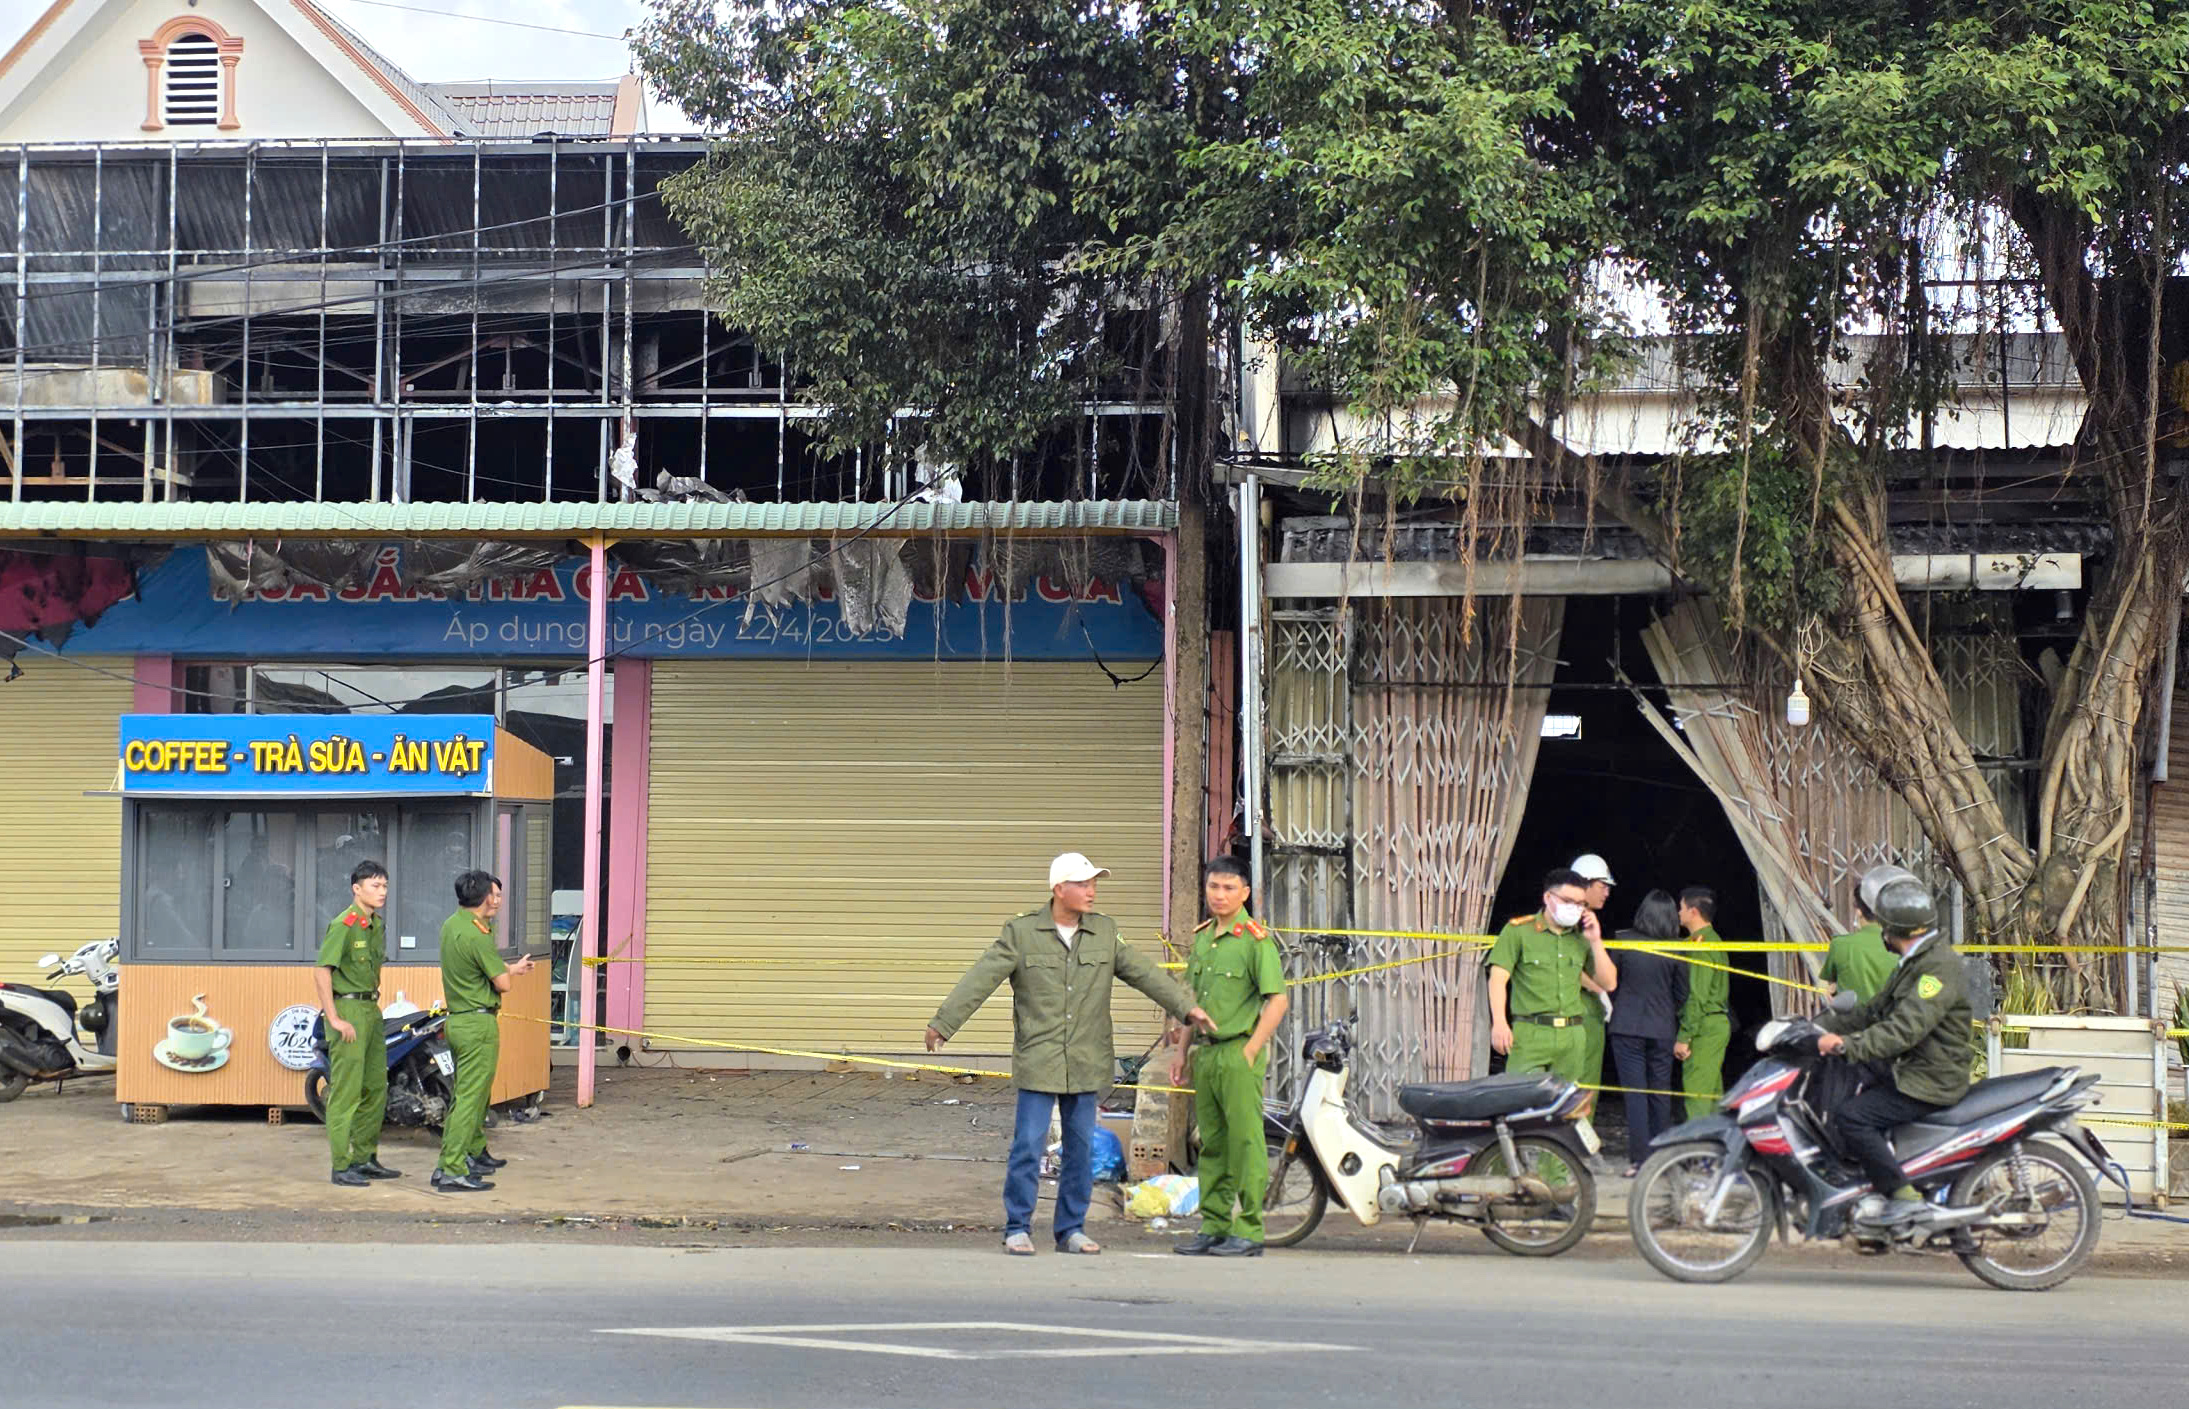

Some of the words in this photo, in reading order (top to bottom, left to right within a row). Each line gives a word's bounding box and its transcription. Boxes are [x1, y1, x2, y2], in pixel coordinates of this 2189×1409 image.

[443, 610, 489, 648] Áp
[499, 615, 586, 648] dụng
[604, 616, 634, 642] ừ
[644, 616, 725, 649] ngày
[125, 740, 227, 772] COFFEE
[250, 736, 304, 772] TRÀ
[309, 735, 366, 772] SỮA
[388, 735, 428, 772] ĂN
[434, 735, 484, 777] VẶT
